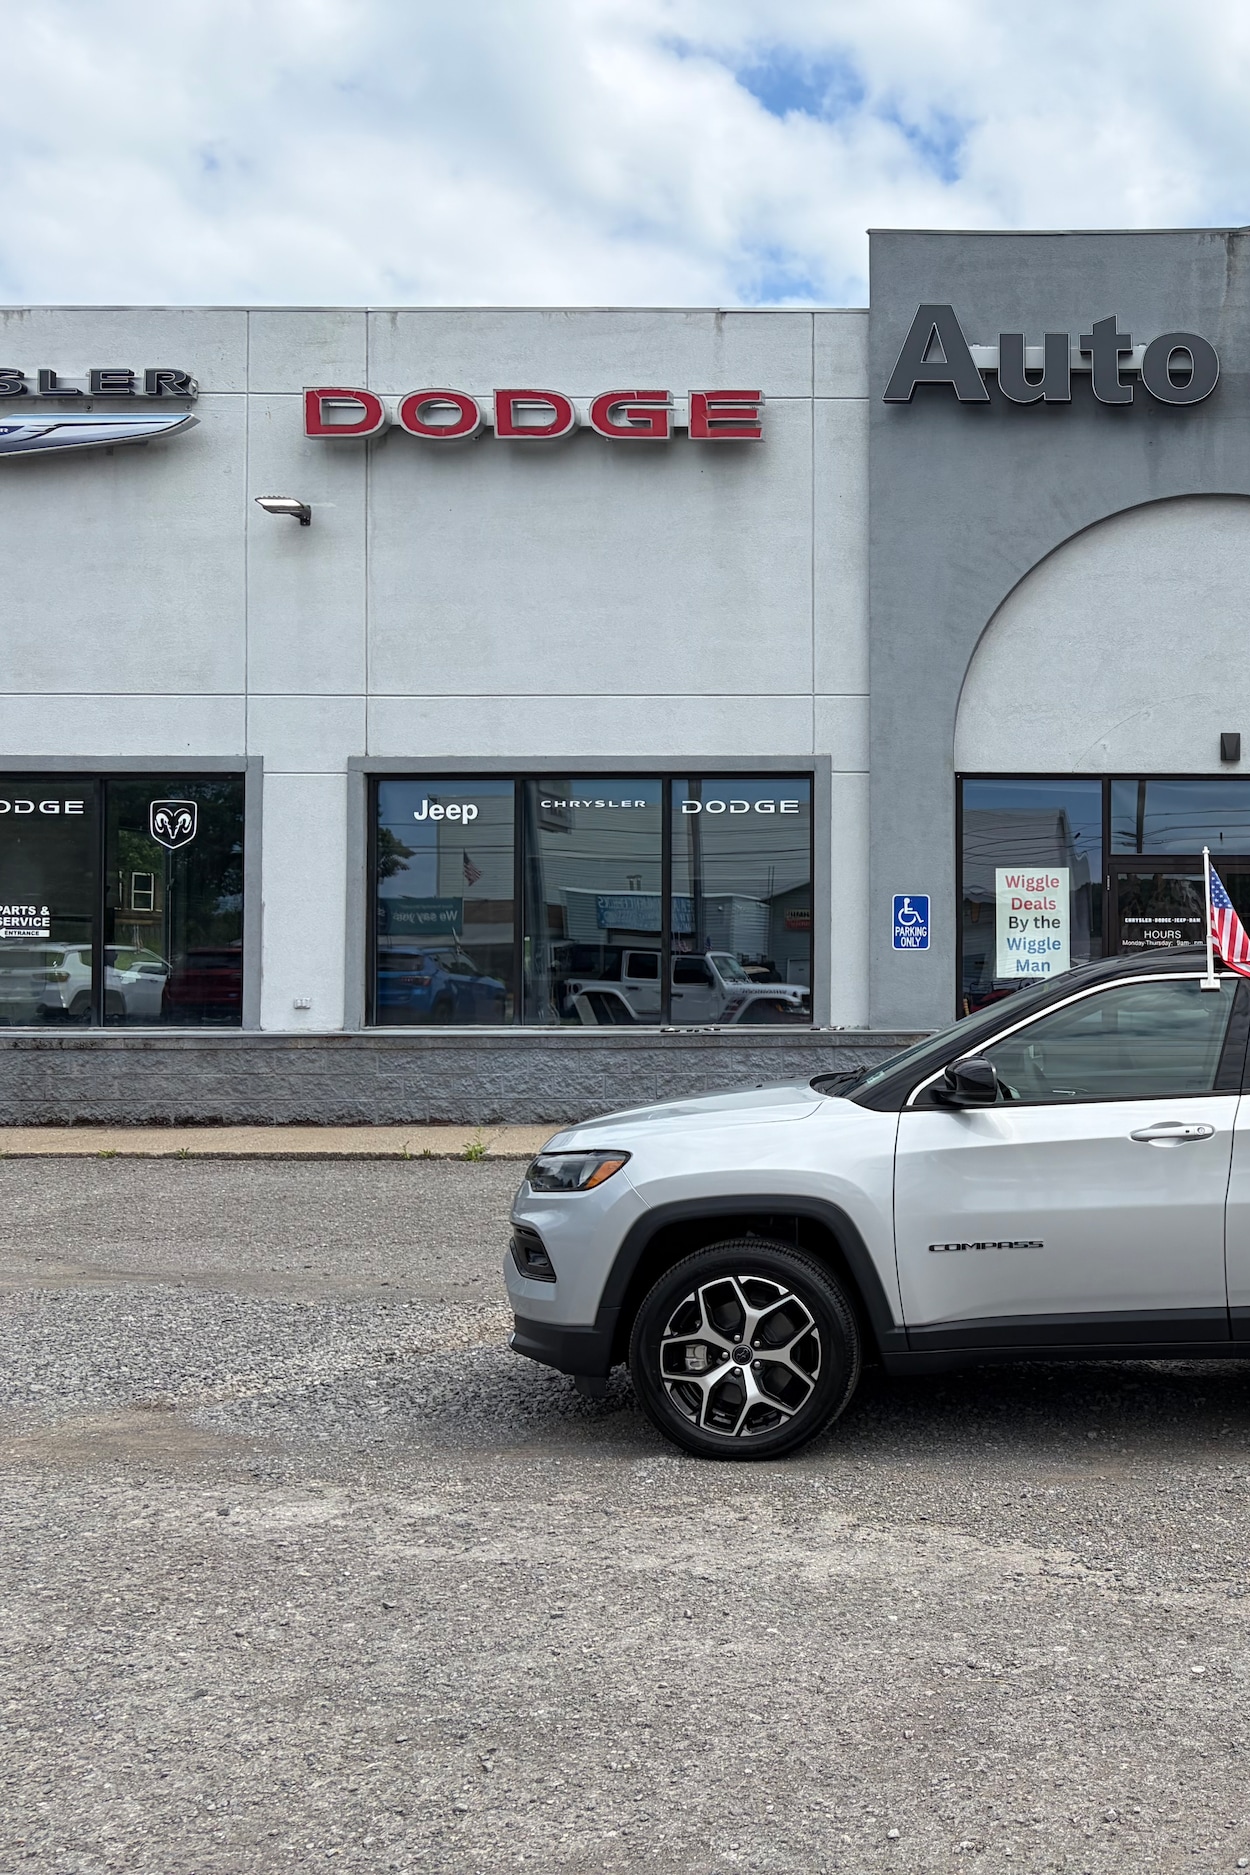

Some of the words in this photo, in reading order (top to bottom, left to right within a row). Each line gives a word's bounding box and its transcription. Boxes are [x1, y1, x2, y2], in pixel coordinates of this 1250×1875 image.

[883, 303, 1220, 405] Auto
[302, 386, 765, 442] DODGE
[540, 800, 646, 808] CHRYSLER
[681, 800, 800, 814] DODGE
[413, 800, 479, 825] Jeep
[1005, 875, 1060, 892] Wiggle
[1011, 897, 1057, 910] Deals
[40, 906, 50, 916] &
[1009, 916, 1029, 932] By
[1033, 915, 1061, 929] the
[895, 926, 927, 937] PARKING
[1143, 930, 1182, 939] HOURS
[900, 937, 922, 948] ONLY
[1006, 937, 1061, 954] Wiggle
[1016, 959, 1051, 972] Man
[928, 1240, 1044, 1252] COMPASS
